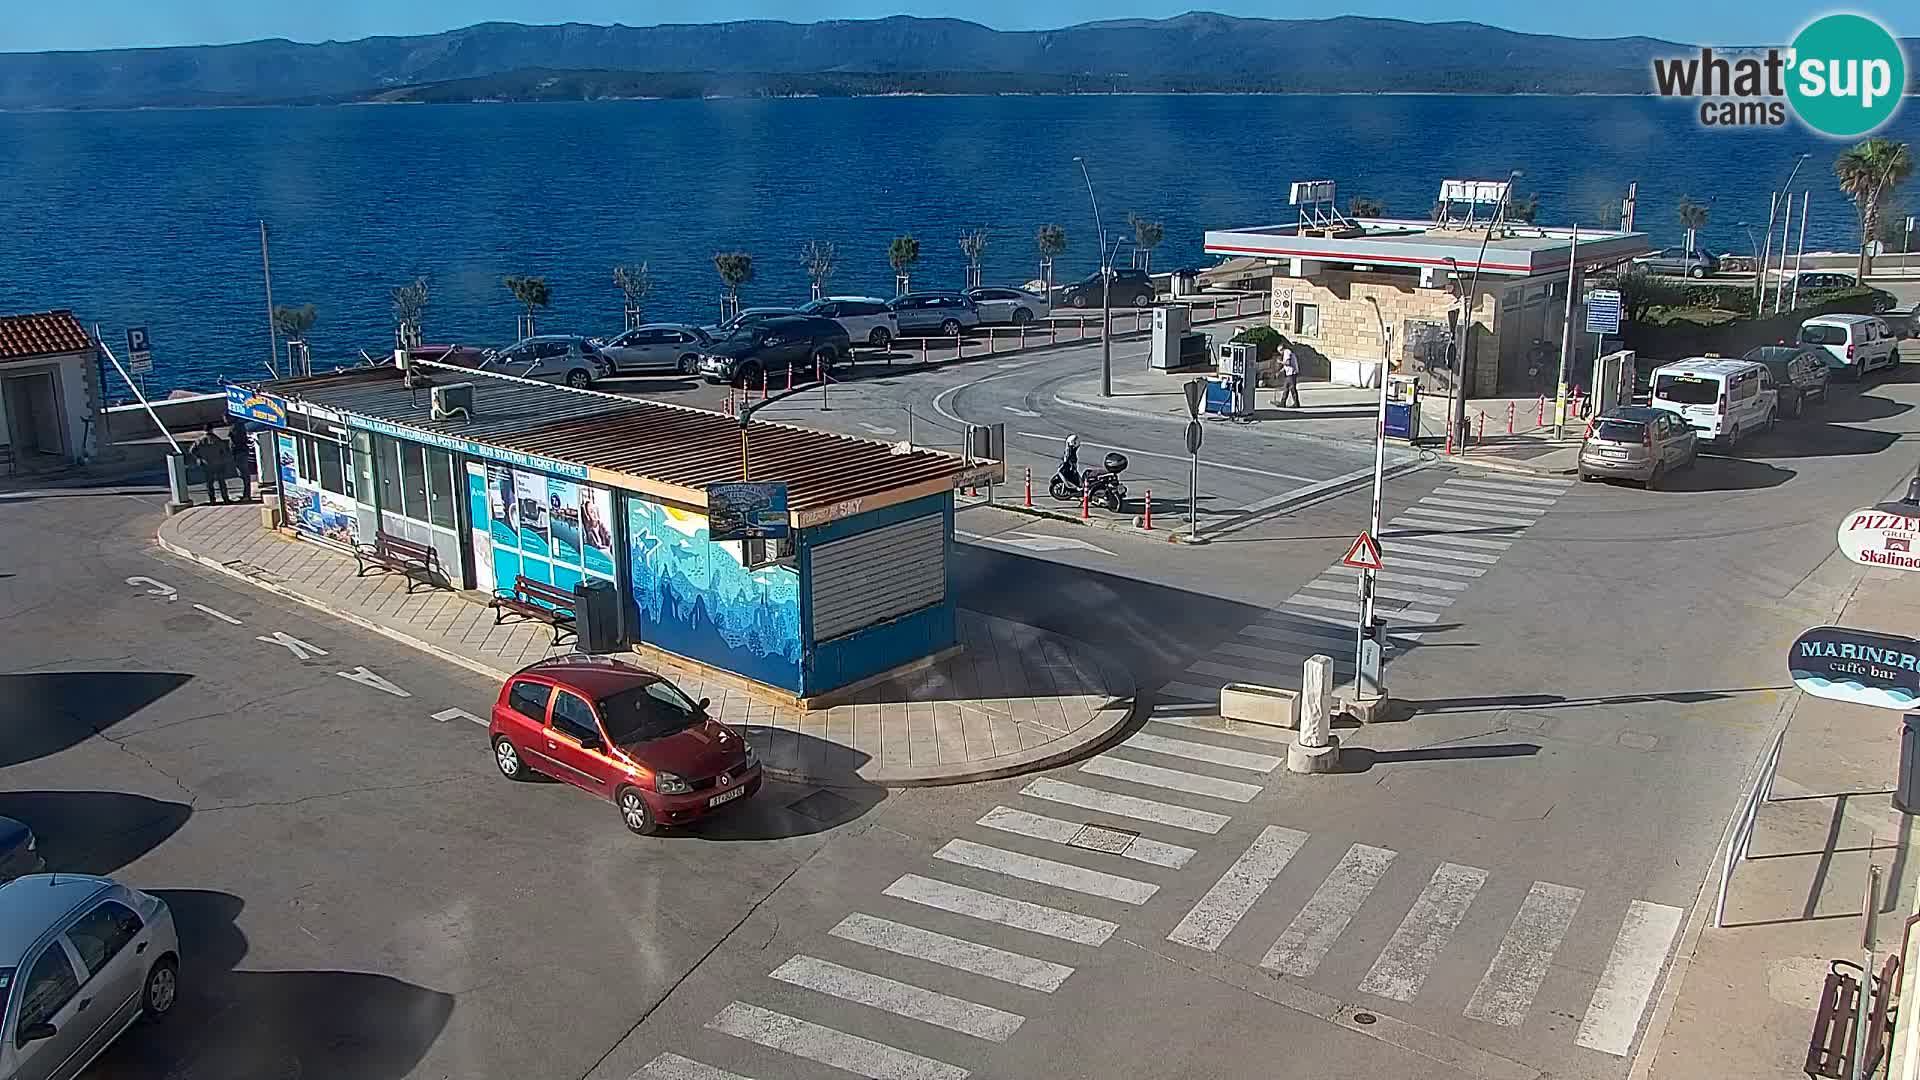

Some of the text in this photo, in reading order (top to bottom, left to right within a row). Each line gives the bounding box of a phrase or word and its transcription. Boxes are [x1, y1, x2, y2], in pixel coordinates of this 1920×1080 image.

[132, 331, 143, 348] P
[437, 436, 469, 452] POSTAJA
[479, 445, 494, 457] BUS
[495, 448, 527, 465] STATION
[528, 456, 556, 472] TICKET
[557, 461, 583, 476] OFFICE
[840, 498, 862, 517] SKY
[1882, 530, 1917, 540] GRILL
[1829, 660, 1896, 680] caffe bar
